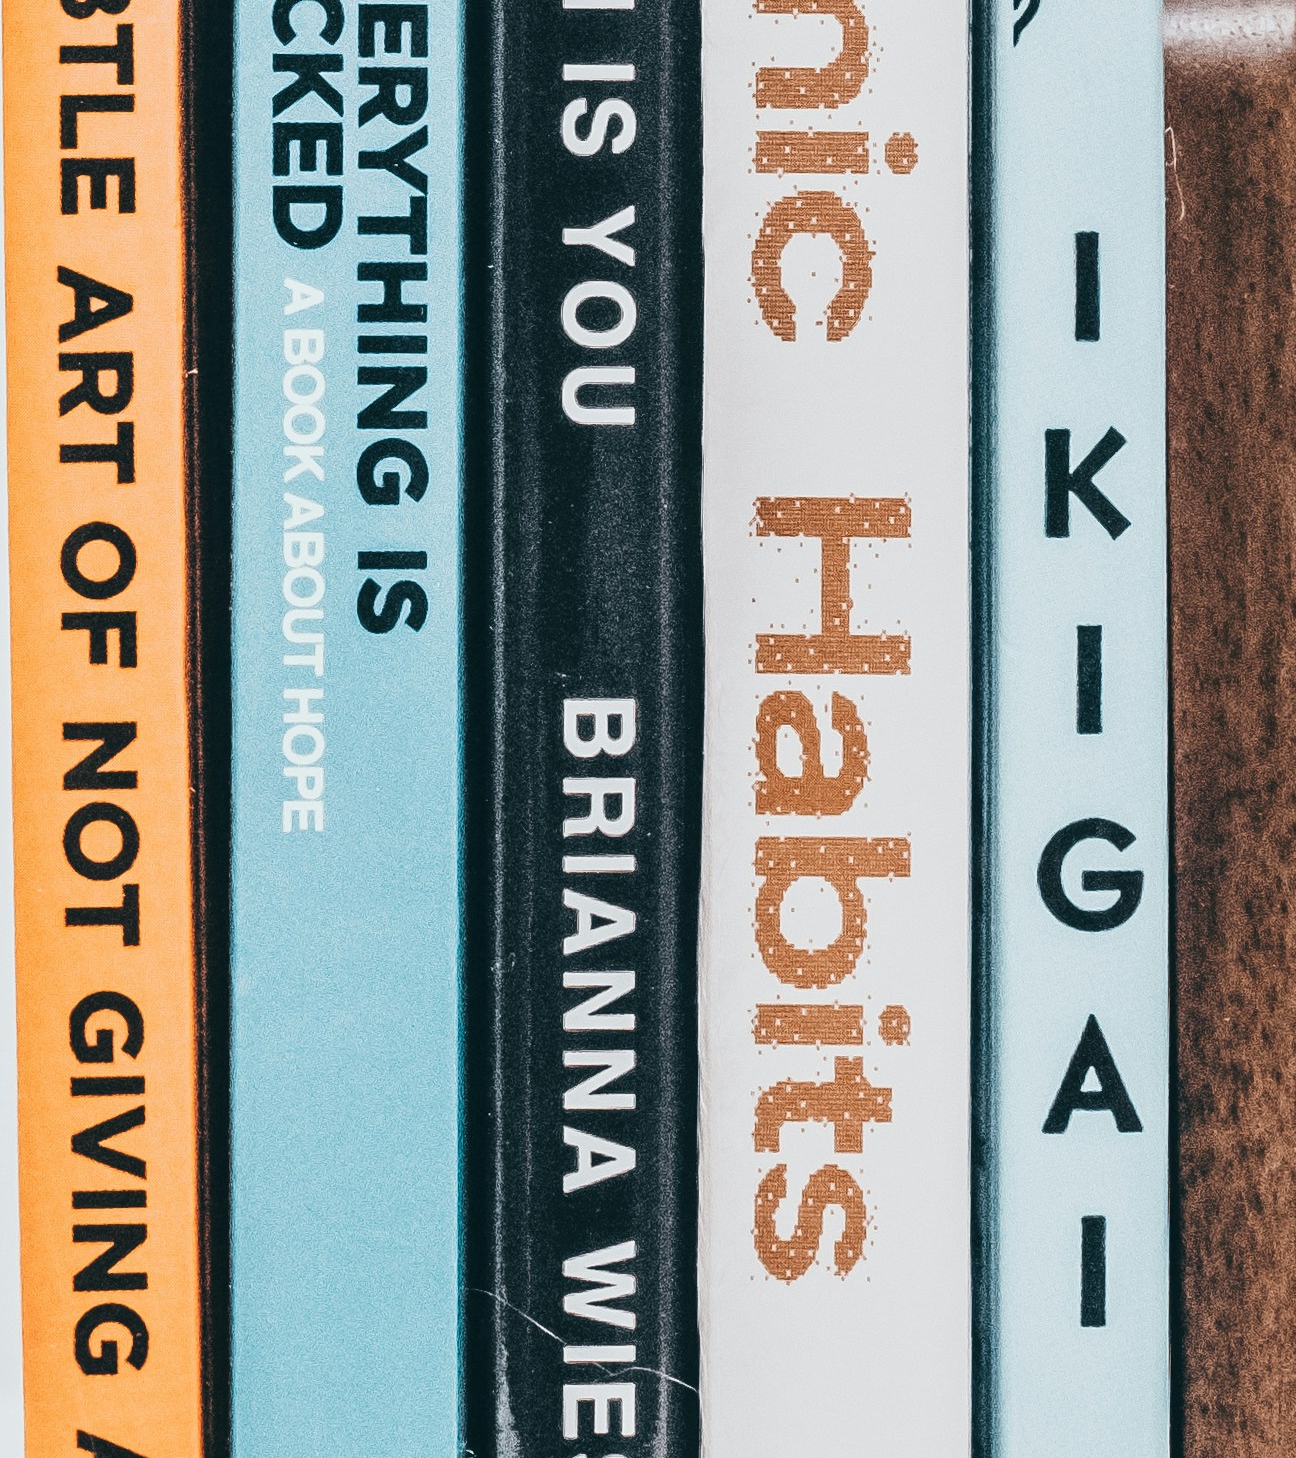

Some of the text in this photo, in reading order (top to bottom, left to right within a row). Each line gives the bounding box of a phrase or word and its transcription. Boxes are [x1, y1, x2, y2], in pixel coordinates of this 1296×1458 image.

[561, 63, 637, 158] IS
[57, 265, 136, 484] ART
[561, 205, 637, 426] YOU
[59, 521, 139, 668] OF
[281, 278, 327, 834] A BOOK ABOUT HOPE
[356, 550, 429, 634] IS
[62, 721, 141, 947] NOT
[752, 495, 912, 1283] Habits
[562, 698, 637, 1194] BRIANNA
[69, 990, 150, 1376] GIVING
